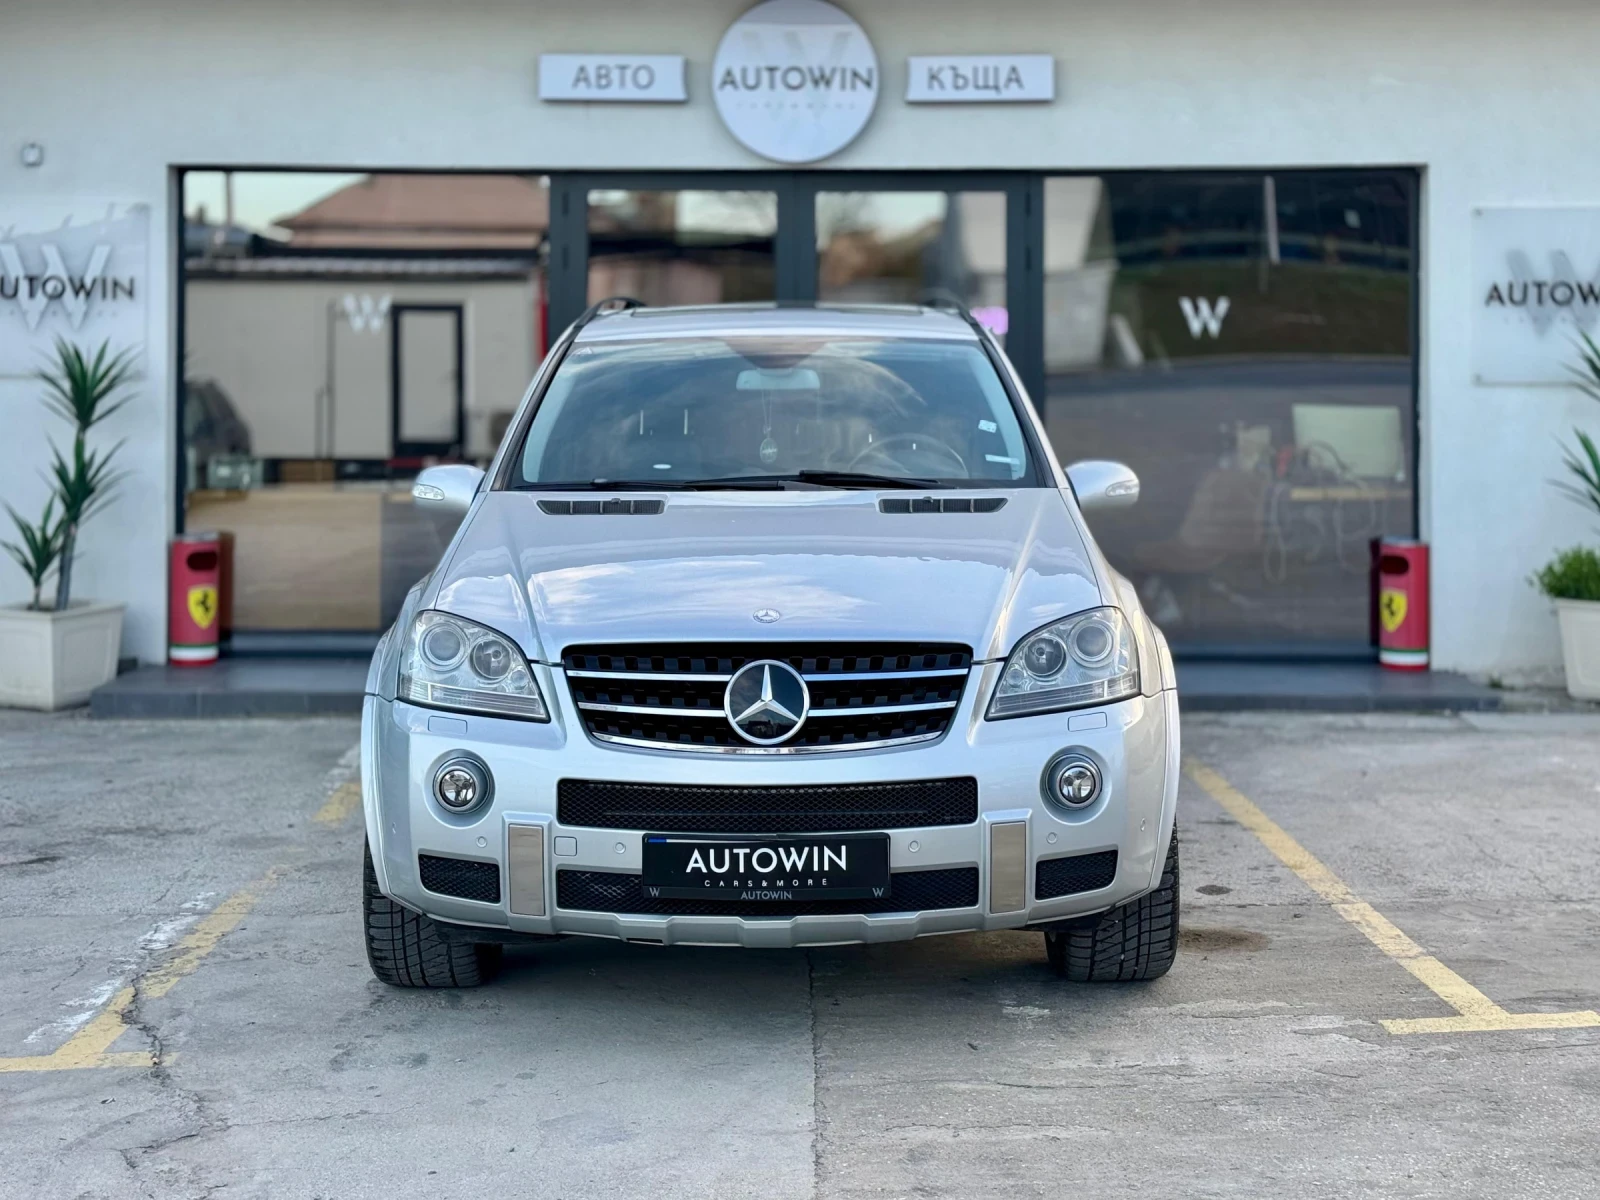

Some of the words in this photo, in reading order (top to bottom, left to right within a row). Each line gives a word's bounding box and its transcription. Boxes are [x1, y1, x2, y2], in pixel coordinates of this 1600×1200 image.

[571, 64, 656, 90] АВТО
[717, 65, 875, 92] AUTOWIN
[926, 64, 1025, 95] КЪЩА
[1178, 295, 1231, 340] W
[685, 845, 847, 874] AUTOWIN
[649, 887, 661, 897] W
[740, 890, 793, 900] AUTOWIN
[872, 887, 884, 897] W
